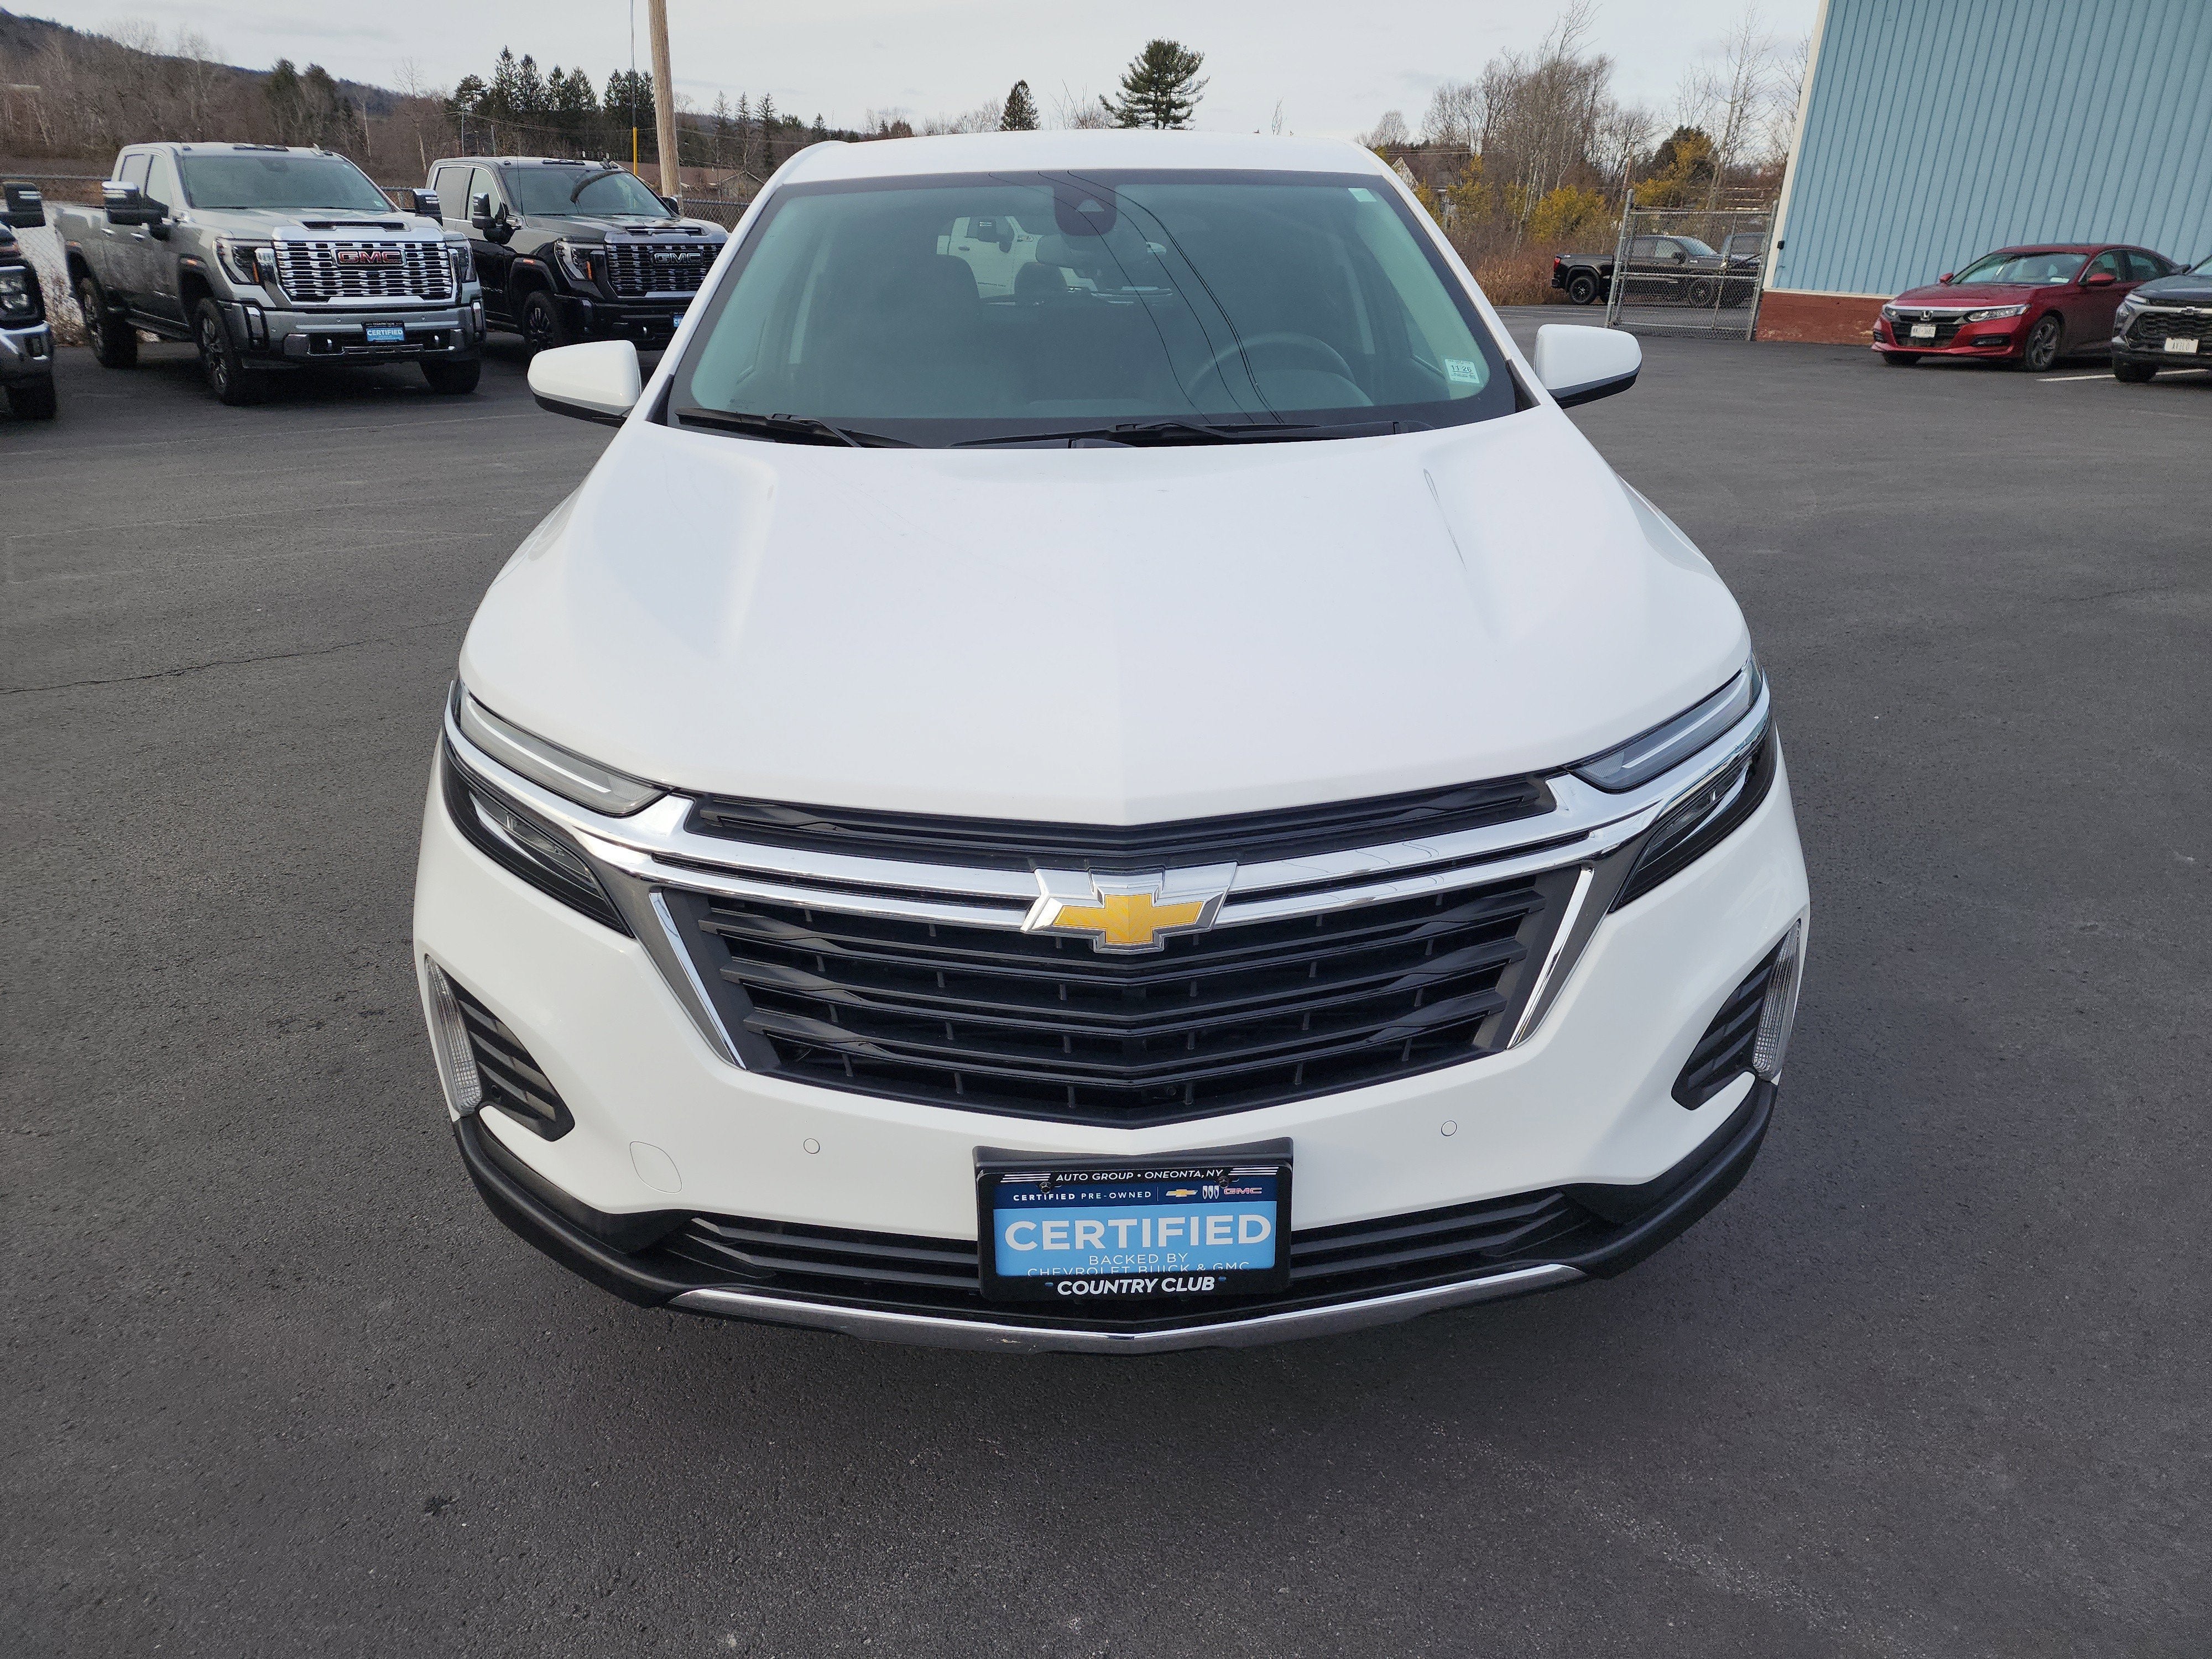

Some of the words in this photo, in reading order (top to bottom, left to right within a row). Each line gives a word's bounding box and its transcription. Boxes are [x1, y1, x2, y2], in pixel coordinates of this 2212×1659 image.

[338, 251, 401, 263] GMC
[654, 253, 701, 263] GMC
[1056, 1173, 1088, 1182] AUTO
[1092, 1172, 1134, 1181] GROUP
[1013, 1193, 1075, 1201] CERTIFIED
[1081, 1191, 1151, 1199] PRE-OWNED
[1005, 1214, 1271, 1251] CERTIFIED
[1089, 1254, 1159, 1265] BACKED
[1167, 1253, 1188, 1262] BY
[1057, 1278, 1159, 1295] COUNTRY
[1161, 1276, 1215, 1292] CLUB
